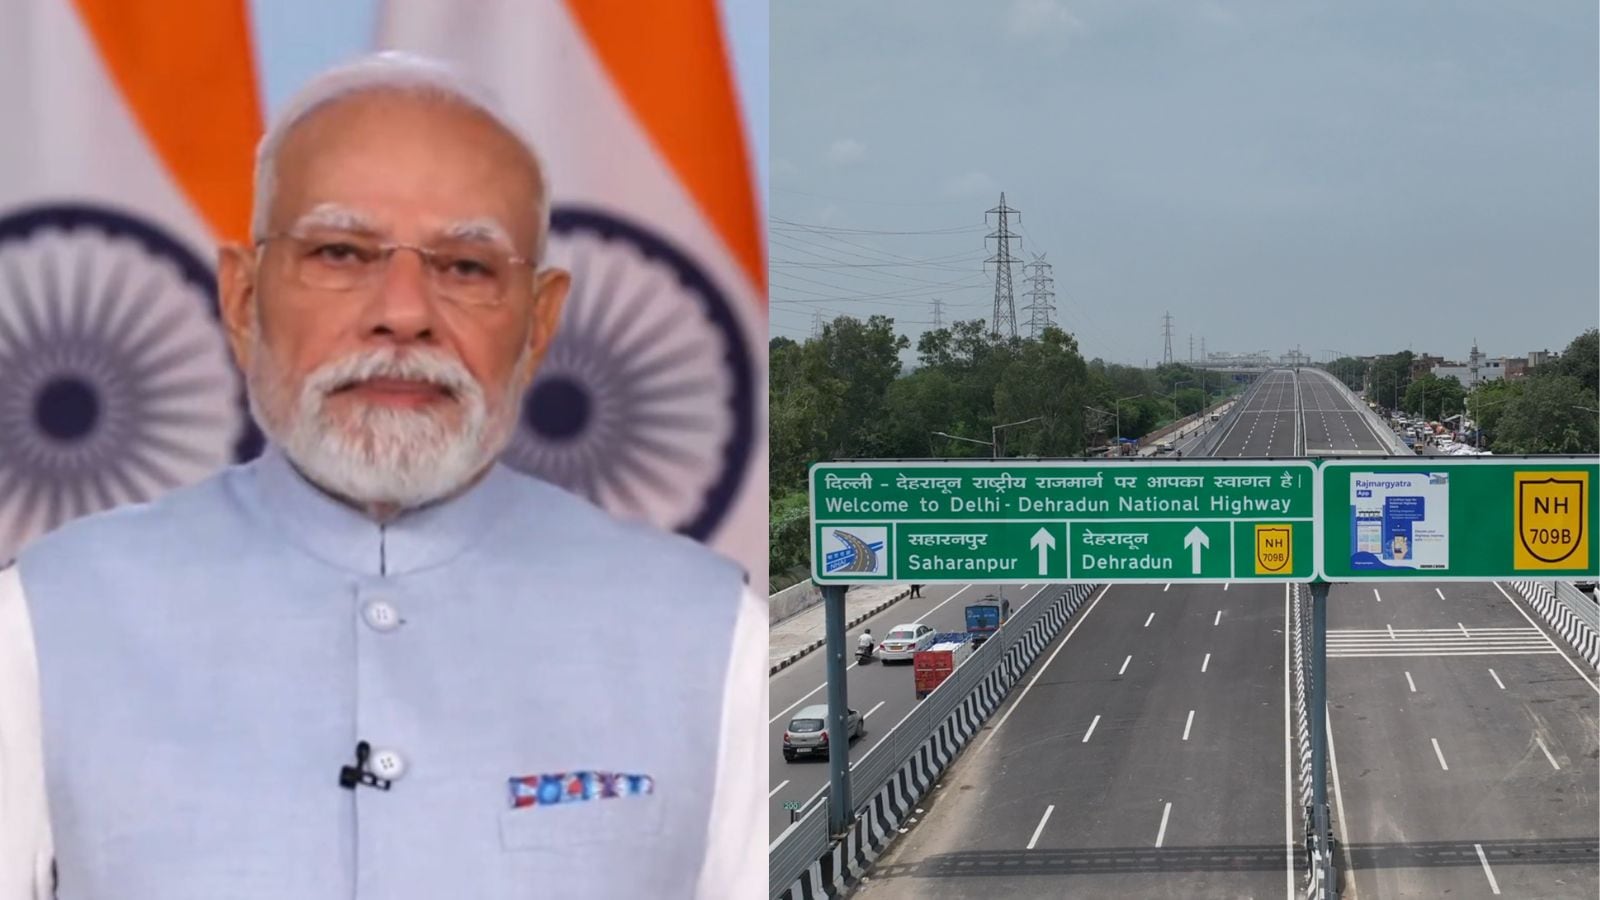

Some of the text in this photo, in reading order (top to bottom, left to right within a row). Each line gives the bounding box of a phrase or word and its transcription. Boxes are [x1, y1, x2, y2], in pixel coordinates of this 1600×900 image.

[825, 473, 872, 489] दिल्ली
[896, 473, 962, 493] देहरादून
[972, 473, 1026, 493] राष्ट्रीय
[1035, 472, 1103, 489] राजमार्ग
[1114, 476, 1137, 489] पर
[1147, 476, 1204, 489] आपका
[1213, 476, 1271, 489] स्वागत
[1355, 480, 1411, 490] Rajmargyatra
[825, 497, 909, 513] Welcome
[920, 499, 939, 513] to
[950, 497, 1000, 513] Delhi
[1019, 497, 1109, 512] Dehradun
[1119, 496, 1199, 512] National
[1210, 496, 1291, 515] Highway
[1534, 497, 1568, 514] NH
[908, 534, 988, 550] सहारनपुर
[1082, 529, 1149, 550] देहरादून
[1265, 538, 1283, 548] NH
[1530, 529, 1571, 545] 709B
[908, 555, 1018, 572] Saharanpur
[1082, 554, 1173, 570] Dehradun
[1263, 553, 1284, 562] 709B
